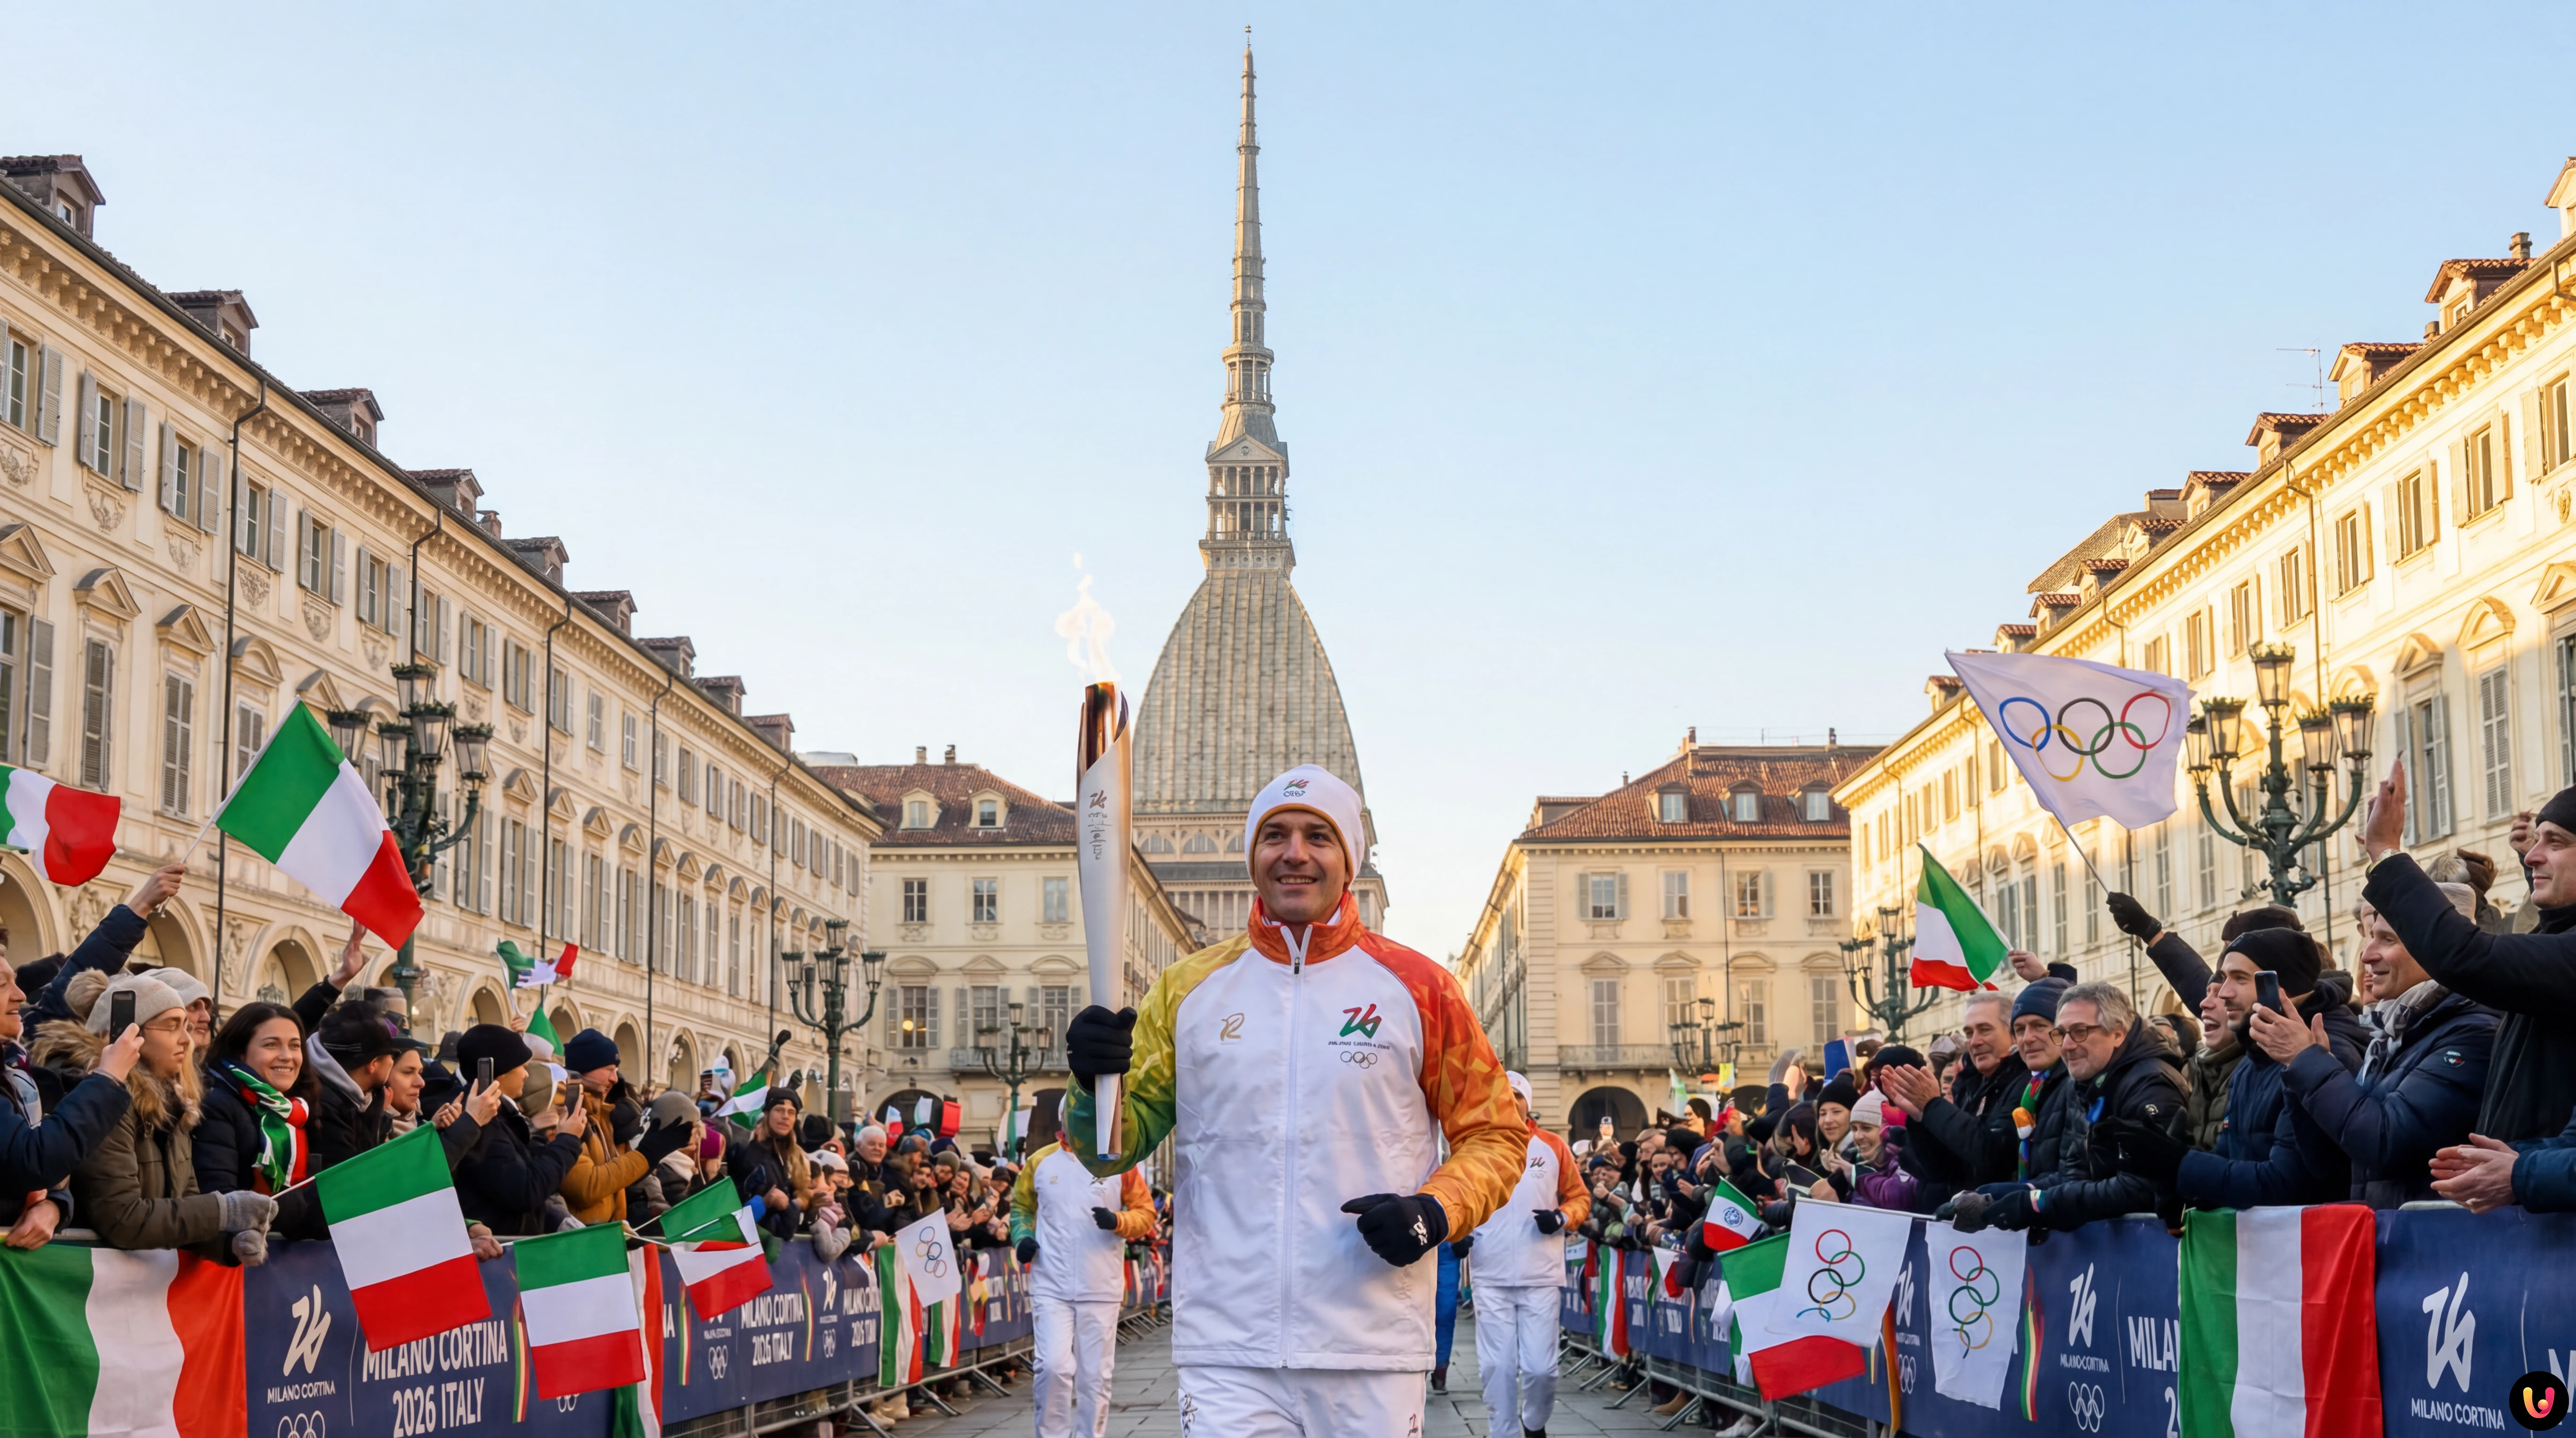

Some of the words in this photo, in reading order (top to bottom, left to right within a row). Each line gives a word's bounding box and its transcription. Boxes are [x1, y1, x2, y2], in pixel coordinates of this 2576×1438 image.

[439, 1320, 508, 1372] CORTINA
[267, 1384, 300, 1404] MILANO
[301, 1380, 336, 1399] CORTINA
[392, 1385, 436, 1438] 2026
[441, 1377, 485, 1429] ITALY
[2411, 1397, 2453, 1422] MILANO
[2454, 1403, 2505, 1431] CORTINA
